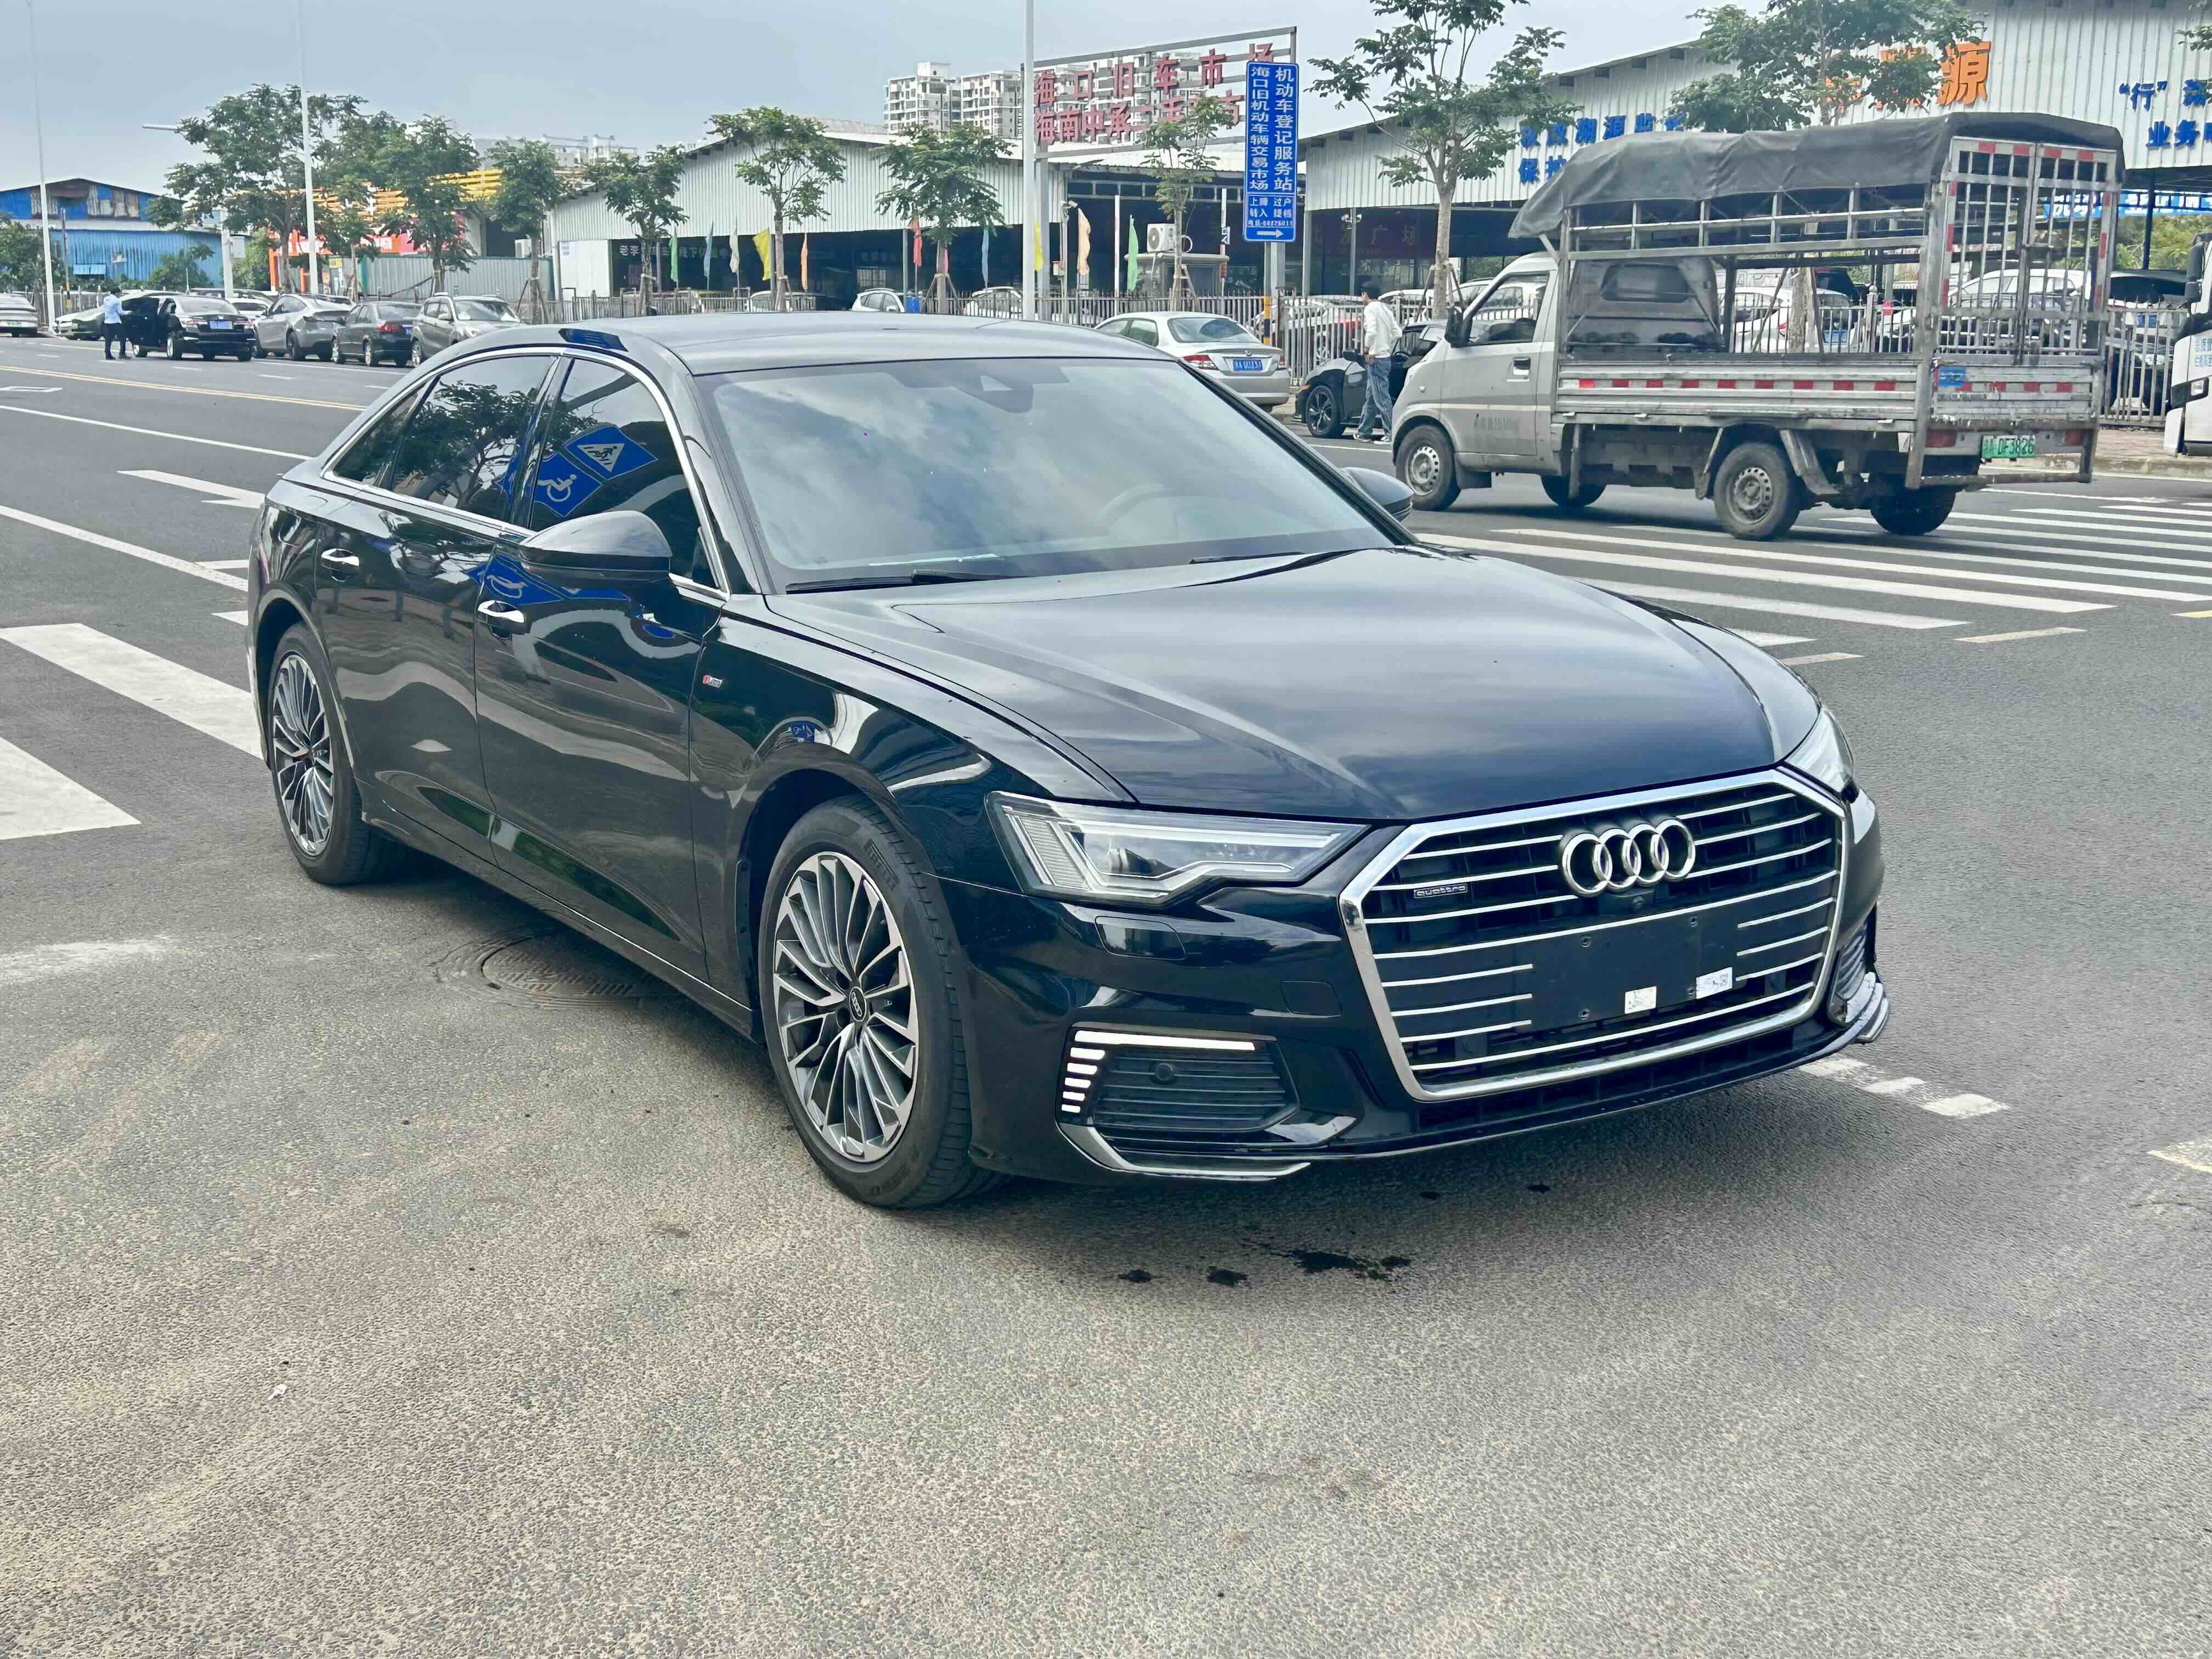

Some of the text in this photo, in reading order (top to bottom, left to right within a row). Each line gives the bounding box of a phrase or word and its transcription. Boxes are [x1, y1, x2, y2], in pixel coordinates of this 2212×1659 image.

[1250, 66, 1270, 190] 海口旧机动车辆交易市场
[1274, 67, 1295, 191] 机动车登记服务站
